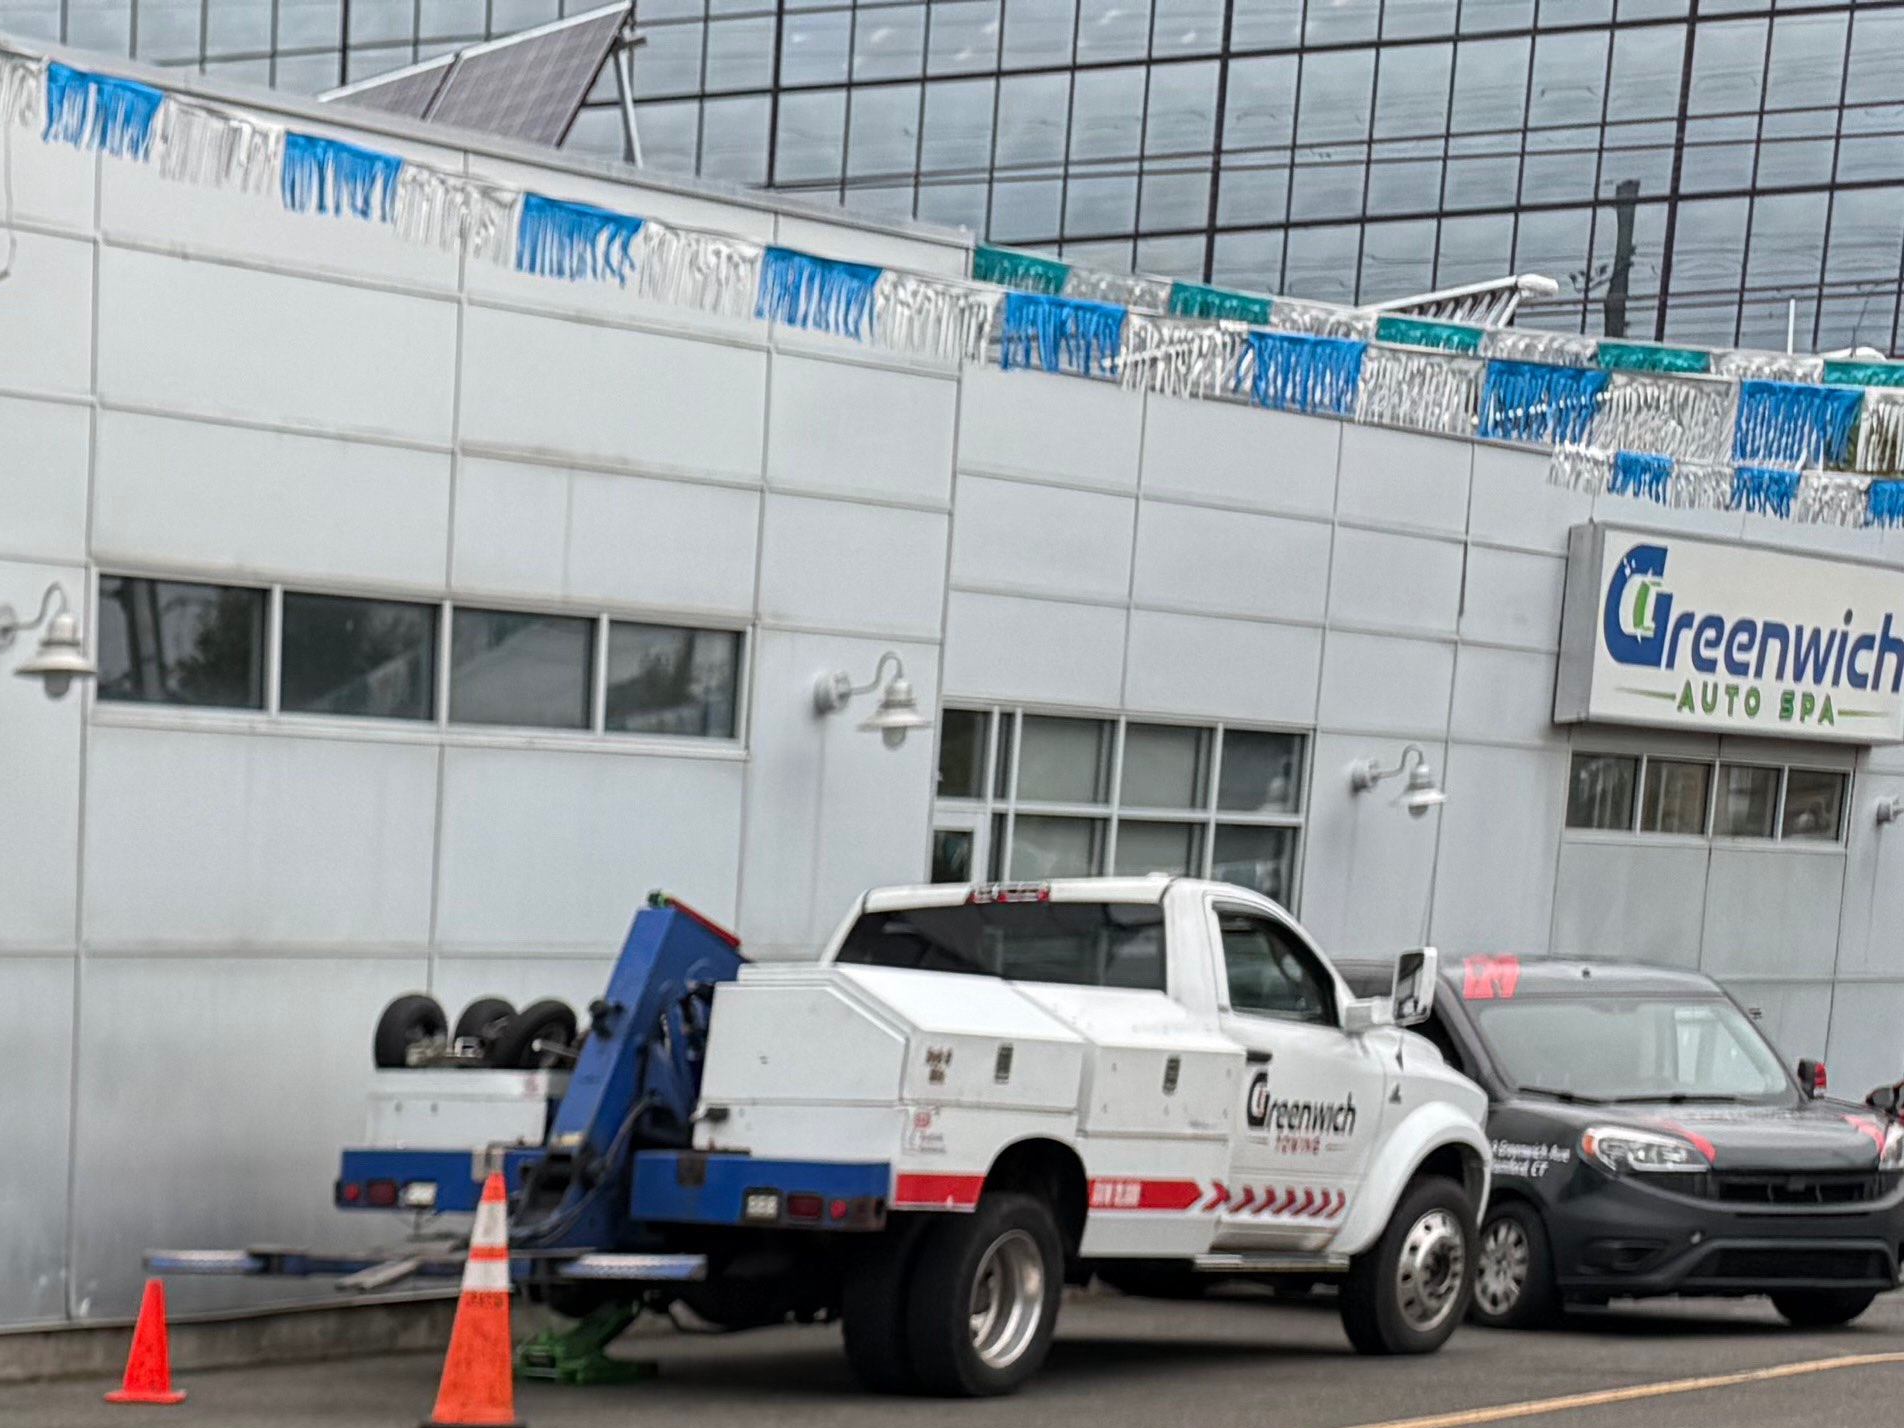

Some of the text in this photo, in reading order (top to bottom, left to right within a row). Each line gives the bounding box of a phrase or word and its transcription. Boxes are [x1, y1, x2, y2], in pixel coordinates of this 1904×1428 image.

[1603, 542, 1904, 694] Greenwich
[1677, 680, 1834, 726] AUTO SPA
[1247, 1071, 1356, 1136] Greenwich
